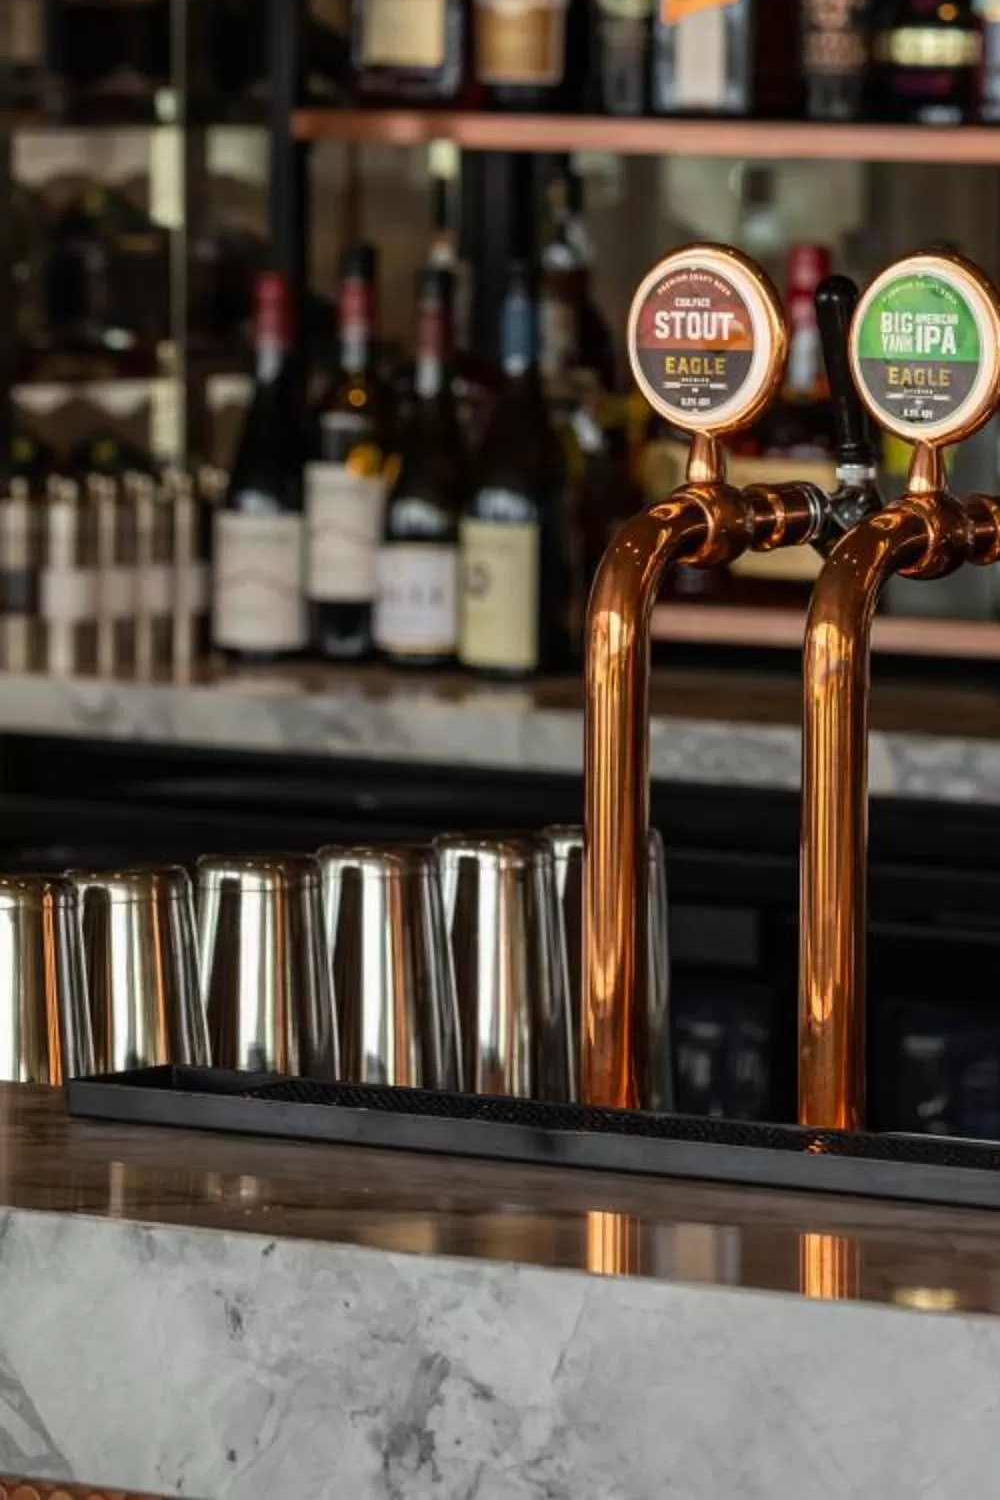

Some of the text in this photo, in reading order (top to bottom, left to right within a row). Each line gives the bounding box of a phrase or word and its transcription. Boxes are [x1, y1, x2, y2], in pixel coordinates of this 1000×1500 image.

[655, 311, 735, 341] STOUT
[881, 312, 913, 334] BIG
[915, 324, 957, 355] IPA
[664, 356, 726, 375] EAGLE
[888, 367, 952, 386] EAGLE
